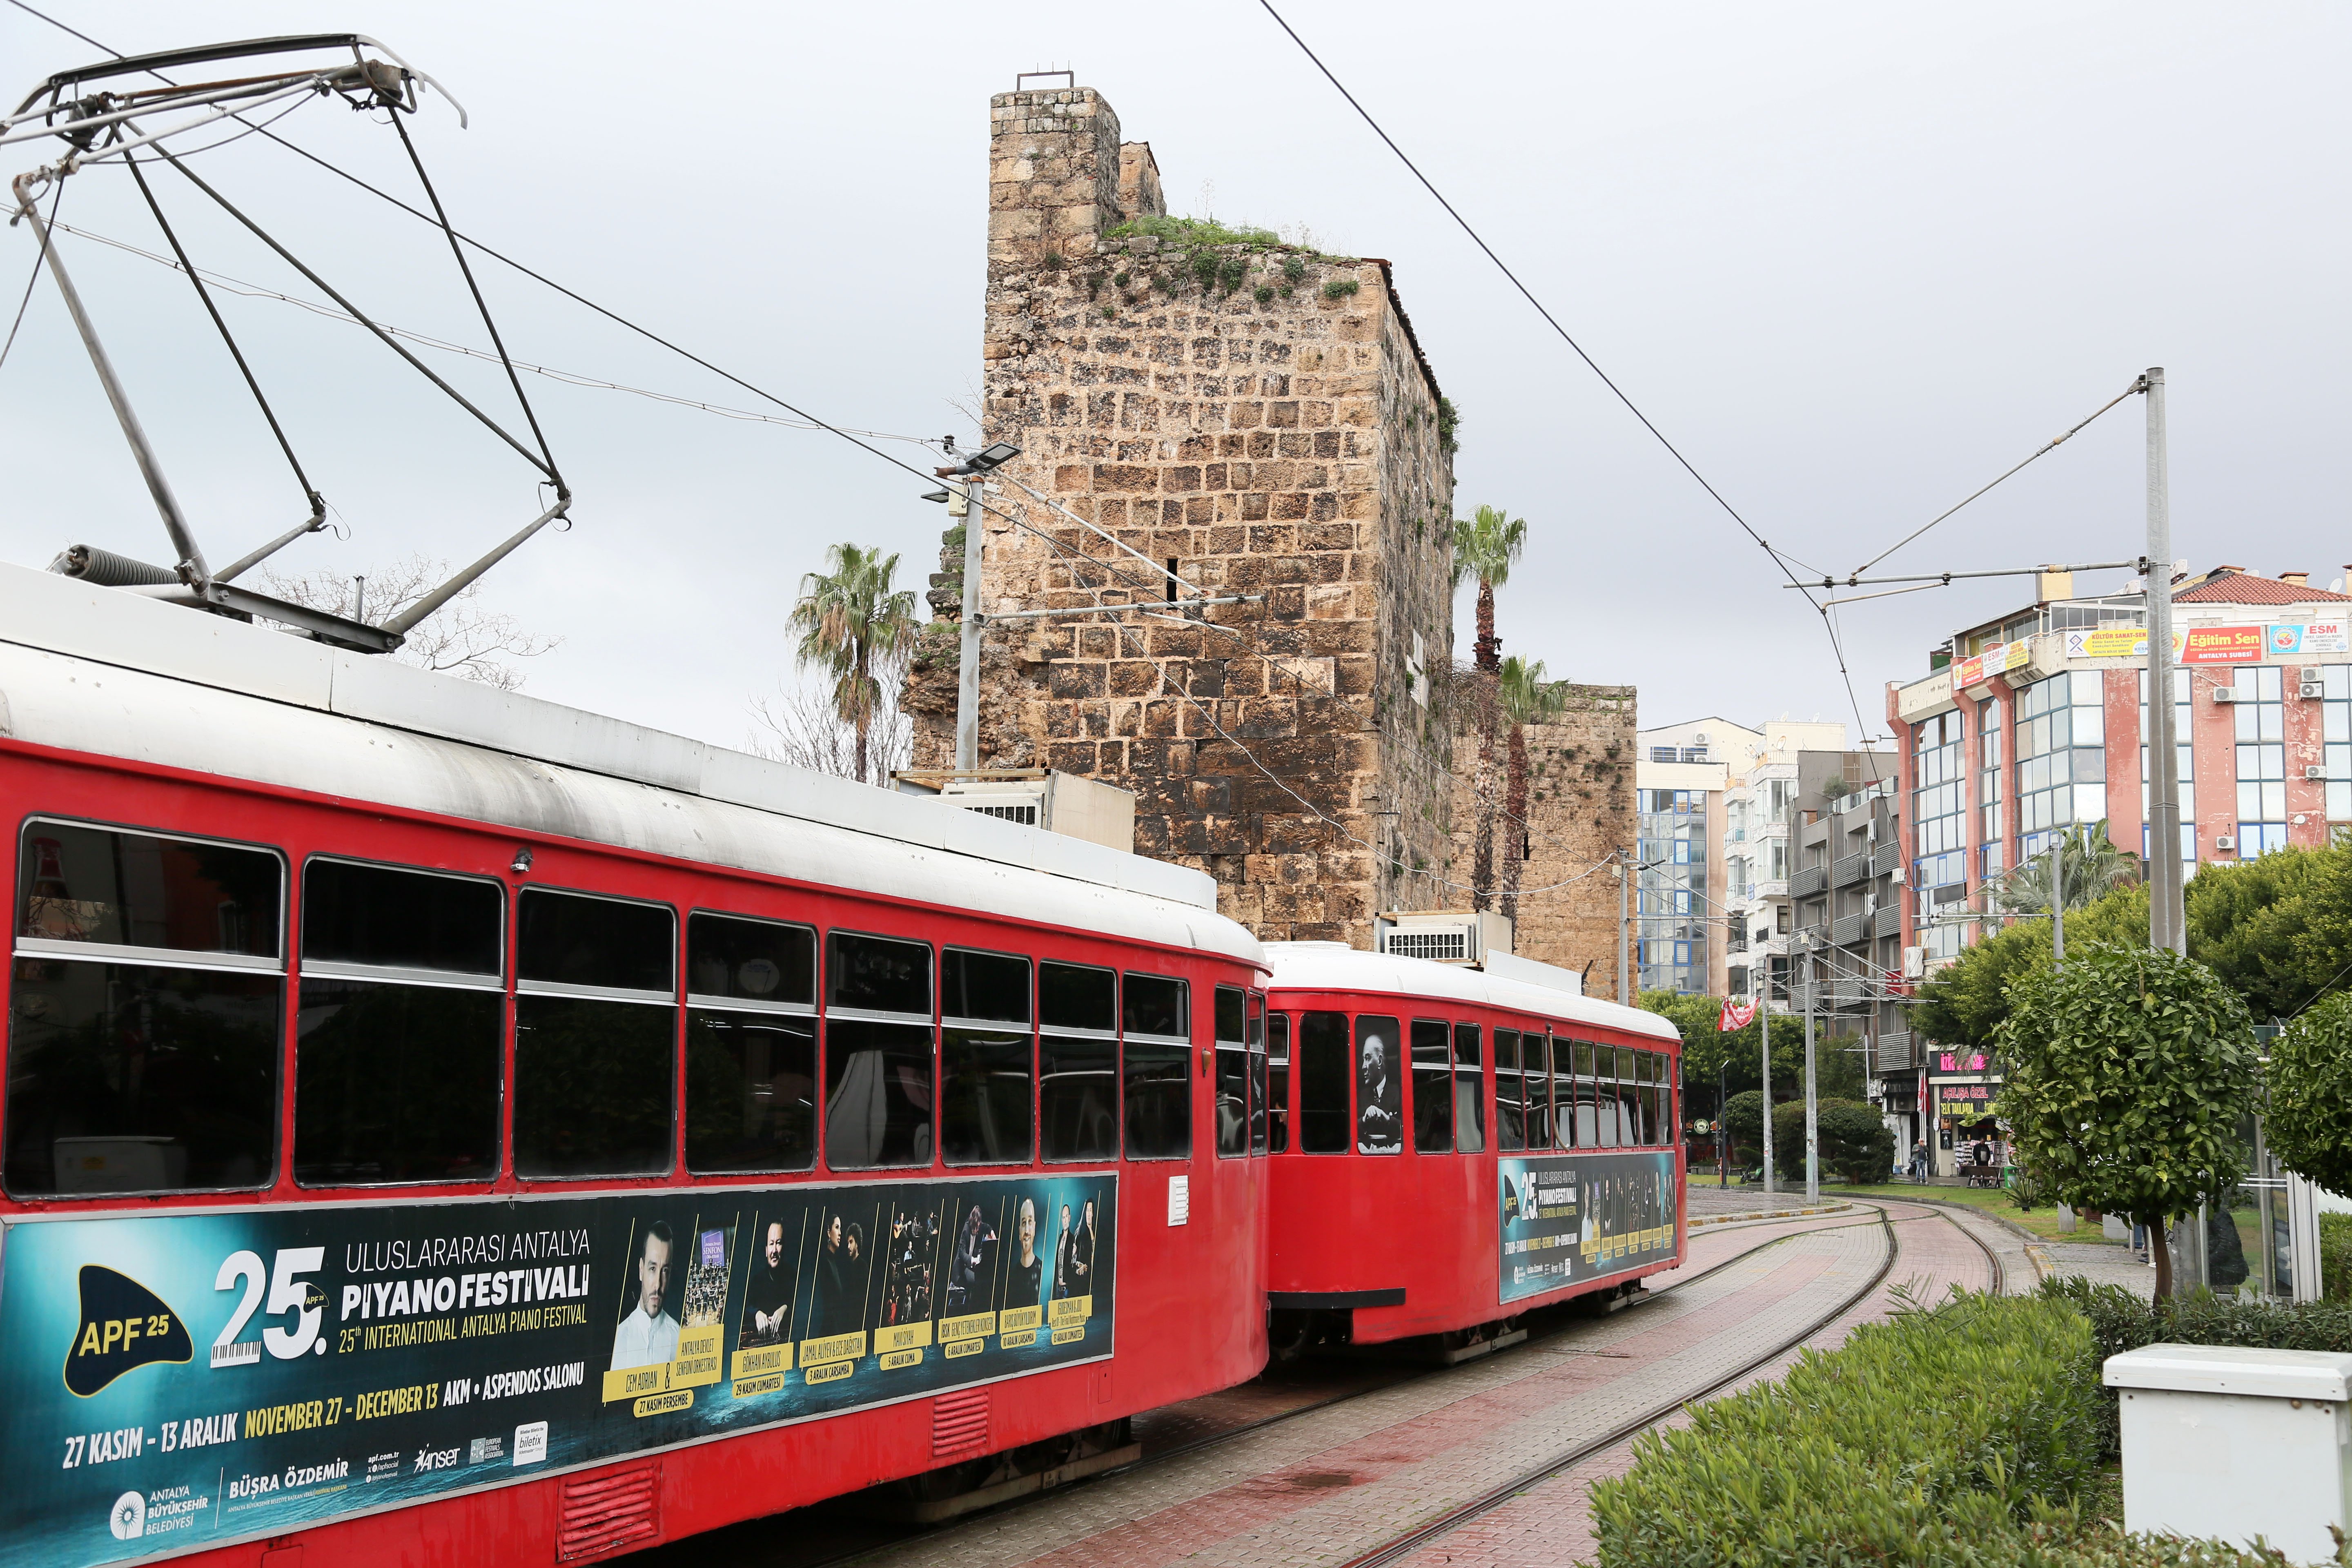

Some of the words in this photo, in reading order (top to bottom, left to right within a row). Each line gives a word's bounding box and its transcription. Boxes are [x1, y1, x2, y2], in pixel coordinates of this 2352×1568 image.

[2309, 625, 2336, 634] ESM
[2190, 634, 2231, 647] Eğitim
[2235, 633, 2259, 644] Sen
[1988, 650, 2000, 661] ESM
[1962, 665, 1974, 675] Eğitim
[1943, 1087, 1969, 1101] AÇILIŞA
[1970, 1085, 1989, 1098] ÖZEL
[346, 1234, 506, 1273] ULUSLARARASI
[510, 1229, 590, 1261] ANTALYA
[306, 1296, 318, 1305] APF
[339, 1325, 362, 1353] 25th
[364, 1318, 457, 1351] INTERNATIONAL
[461, 1313, 506, 1339] ANTALYA
[510, 1309, 541, 1332] PIANO
[543, 1303, 587, 1328] FESTIVAL
[941, 1321, 950, 1339] İBSK
[951, 1321, 960, 1339] GENÇ
[961, 1318, 980, 1335] YETENEKLER
[980, 1313, 993, 1332] KONSERİ
[1004, 1314, 1013, 1330] BARIŞ
[78, 1317, 143, 1357] APF
[147, 1314, 169, 1337] 25
[893, 1328, 903, 1348] MAVİ
[903, 1327, 913, 1345] SİYAH
[1003, 1337, 1007, 1347] 10
[1007, 1336, 1018, 1345] ARALIK
[1018, 1333, 1034, 1345] ÇARŞAMBA
[1057, 1332, 1067, 1342] ARALIK
[1067, 1327, 1082, 1339] CUMARTESİ
[681, 1340, 699, 1356] ANTALYA
[700, 1338, 714, 1354] DEVLET
[803, 1345, 817, 1362] JAMAL
[818, 1339, 832, 1359] ALİYEV
[832, 1344, 835, 1357] &
[948, 1348, 951, 1356] 6
[951, 1344, 963, 1356] ARALIK
[963, 1340, 981, 1353] CUMARTESİ
[676, 1357, 693, 1376] SENFONİ
[694, 1356, 717, 1374] ORKESTRASI
[743, 1352, 761, 1373] GÖKHAN
[761, 1351, 781, 1369] AYBULUS
[888, 1357, 891, 1367] 5
[891, 1354, 904, 1366] ARALIK
[905, 1353, 915, 1363] CUMA
[626, 1374, 637, 1393] CEM
[638, 1370, 657, 1391] ADRIAN
[665, 1363, 670, 1390] &
[810, 1370, 813, 1381] 3
[813, 1367, 828, 1380] ARALIK
[829, 1364, 849, 1380] ÇARŞAMBA
[736, 1384, 742, 1396] 29
[742, 1381, 756, 1394] KASIM
[757, 1375, 781, 1392] CUMARTESİ
[639, 1401, 646, 1413] 27
[647, 1398, 662, 1412] KASIM
[663, 1393, 688, 1409] PERŞEMBE
[62, 1435, 85, 1470] 27
[88, 1426, 143, 1466] KASIM
[161, 1421, 178, 1453] 13
[180, 1412, 238, 1450] ARALIK
[244, 1400, 323, 1439] NOVEMBER
[325, 1397, 343, 1426] 27
[355, 1386, 423, 1421] DECEMBER
[425, 1383, 439, 1410] 13
[443, 1379, 470, 1407] AKM
[482, 1370, 541, 1401] ASPENDOS
[543, 1361, 584, 1390] SALONU
[485, 1444, 500, 1452] FESTIVALS
[486, 1437, 501, 1446] EUROPEAN
[519, 1434, 541, 1448] biletix
[368, 1451, 399, 1463] apf.com.tr
[485, 1450, 503, 1459] ASSOCIATION
[229, 1474, 280, 1500] BÜŞRA
[285, 1457, 348, 1488] ÖZDEMİR
[149, 1485, 190, 1503] ANTALYA
[228, 1504, 246, 1512] ANTALYA
[270, 1496, 287, 1505] BELEDİYE
[287, 1493, 303, 1502] BAŞKAN
[148, 1495, 208, 1519] BÜYÜKŞEHİR
[146, 1513, 194, 1536] BELEDİYESİ
